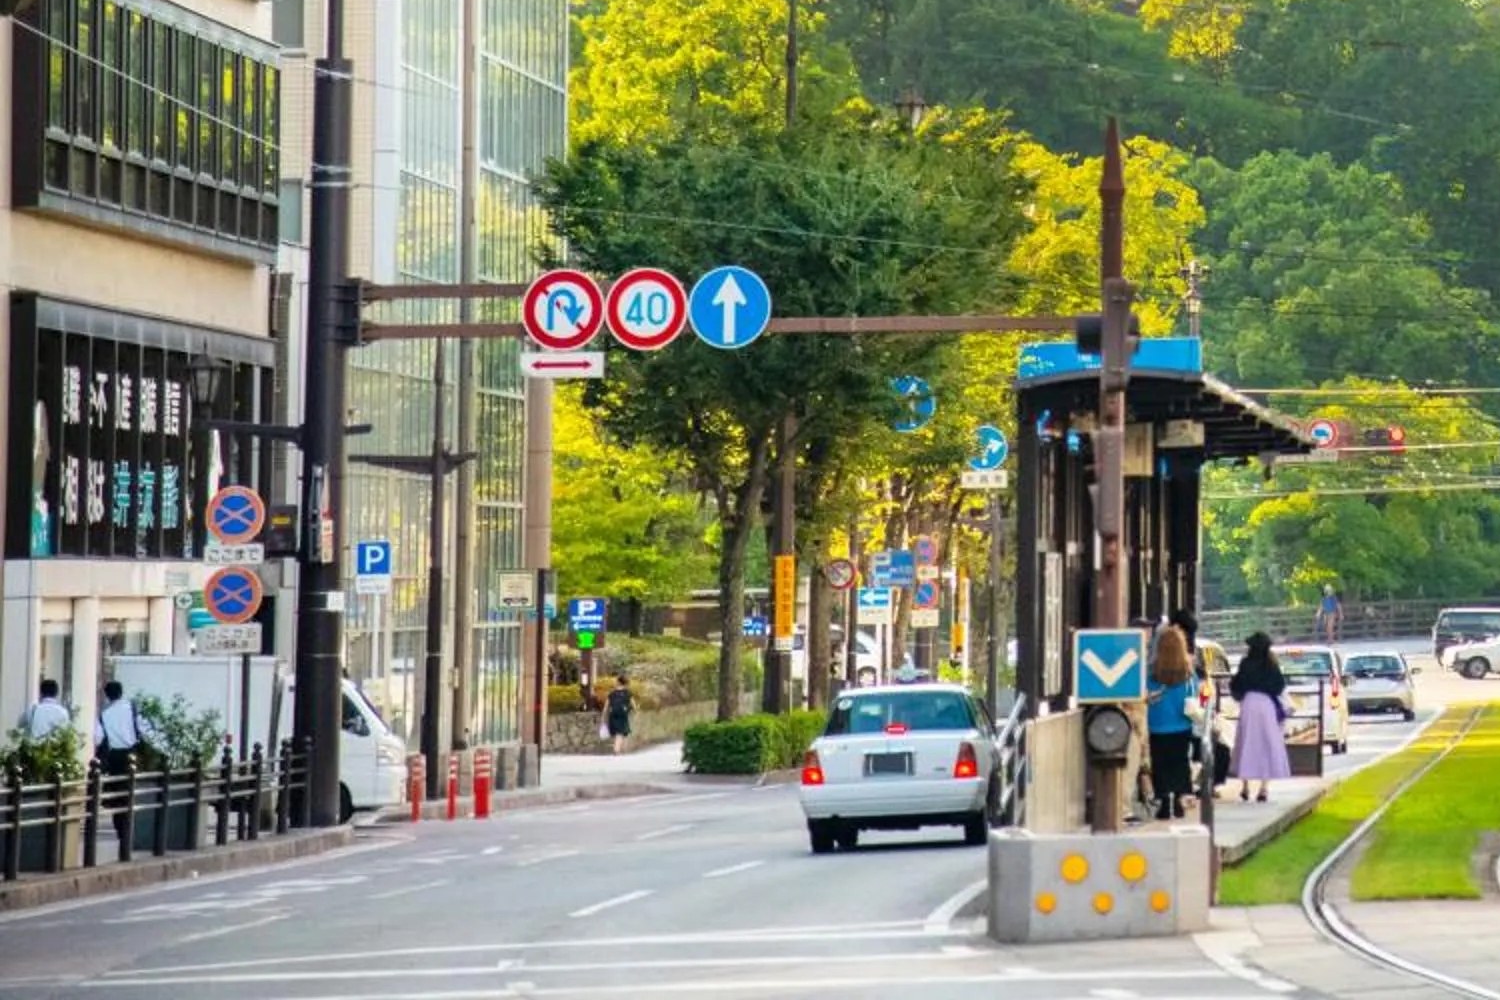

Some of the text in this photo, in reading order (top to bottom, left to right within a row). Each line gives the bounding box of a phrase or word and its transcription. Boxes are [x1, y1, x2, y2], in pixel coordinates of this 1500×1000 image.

[625, 290, 668, 326] 40
[208, 547, 259, 563] ここまで
[364, 545, 385, 572] P
[578, 600, 597, 617] P
